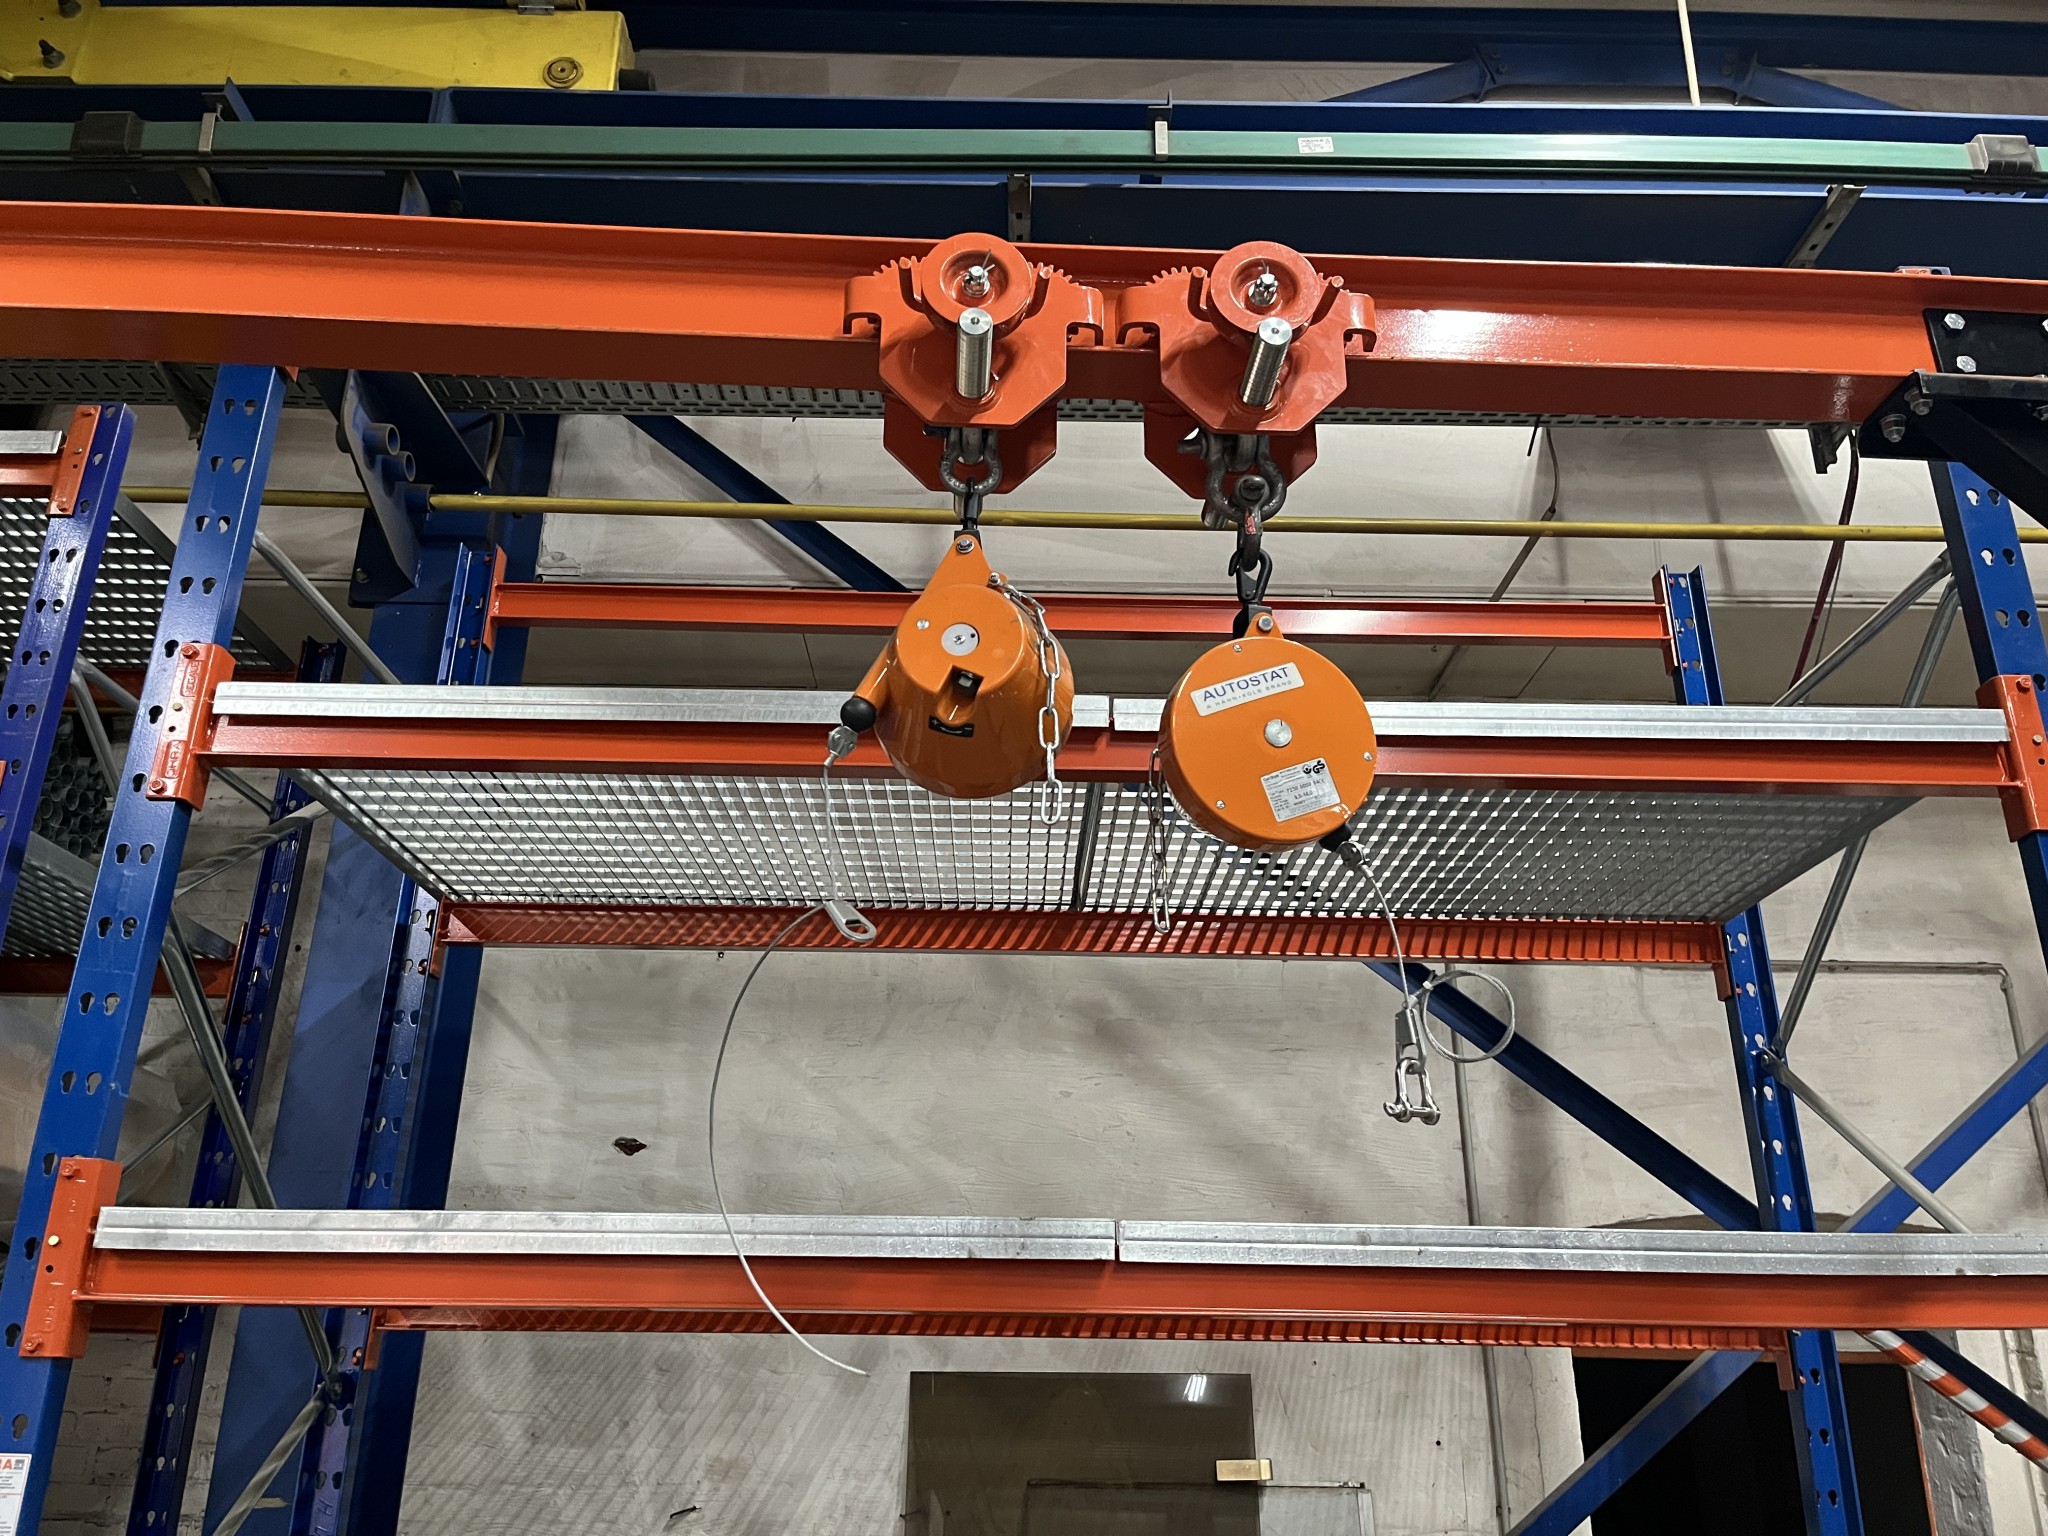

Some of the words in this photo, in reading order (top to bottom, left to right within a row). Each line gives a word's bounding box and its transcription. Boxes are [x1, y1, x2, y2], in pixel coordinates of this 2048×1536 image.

[1203, 667, 1288, 702] AUTOSTAT
[1265, 680, 1292, 691] BRAND
[1313, 760, 1325, 774] GS
